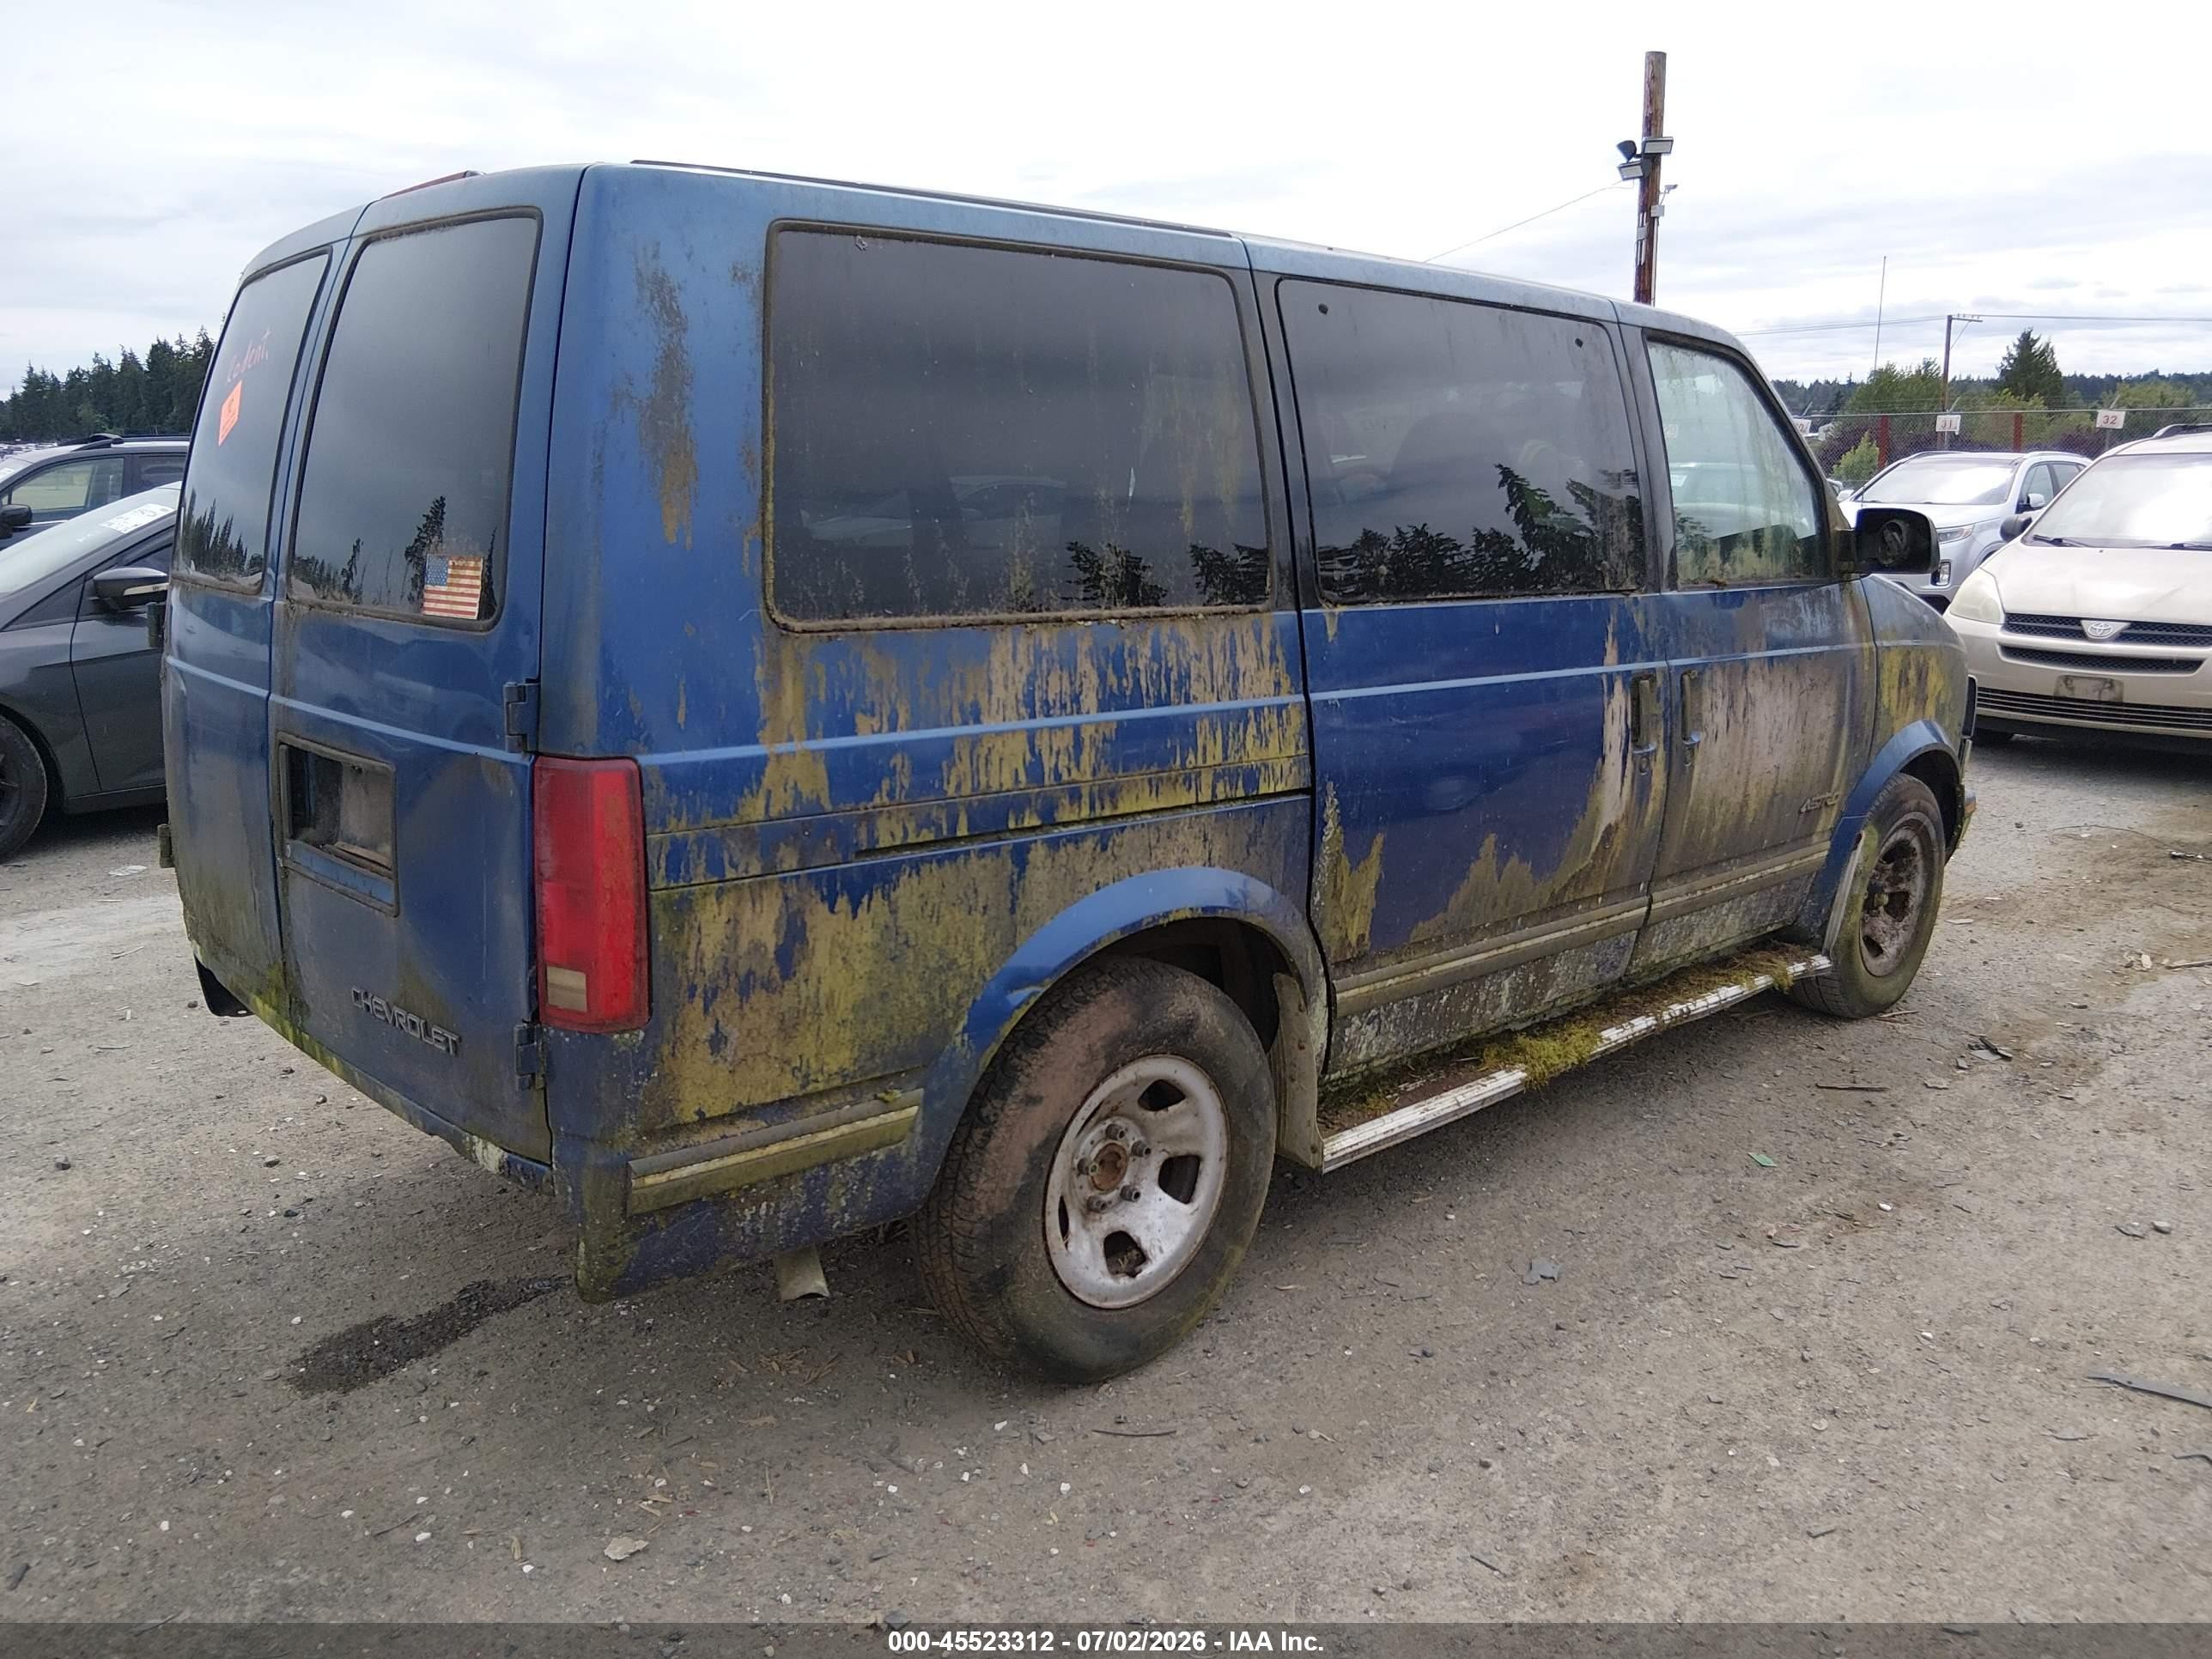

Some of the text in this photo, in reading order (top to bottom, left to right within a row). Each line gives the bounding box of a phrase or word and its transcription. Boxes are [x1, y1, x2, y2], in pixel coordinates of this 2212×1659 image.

[1941, 419, 1952, 428] 31
[2103, 415, 2118, 425] 32
[351, 987, 461, 1056] CHEVROLET
